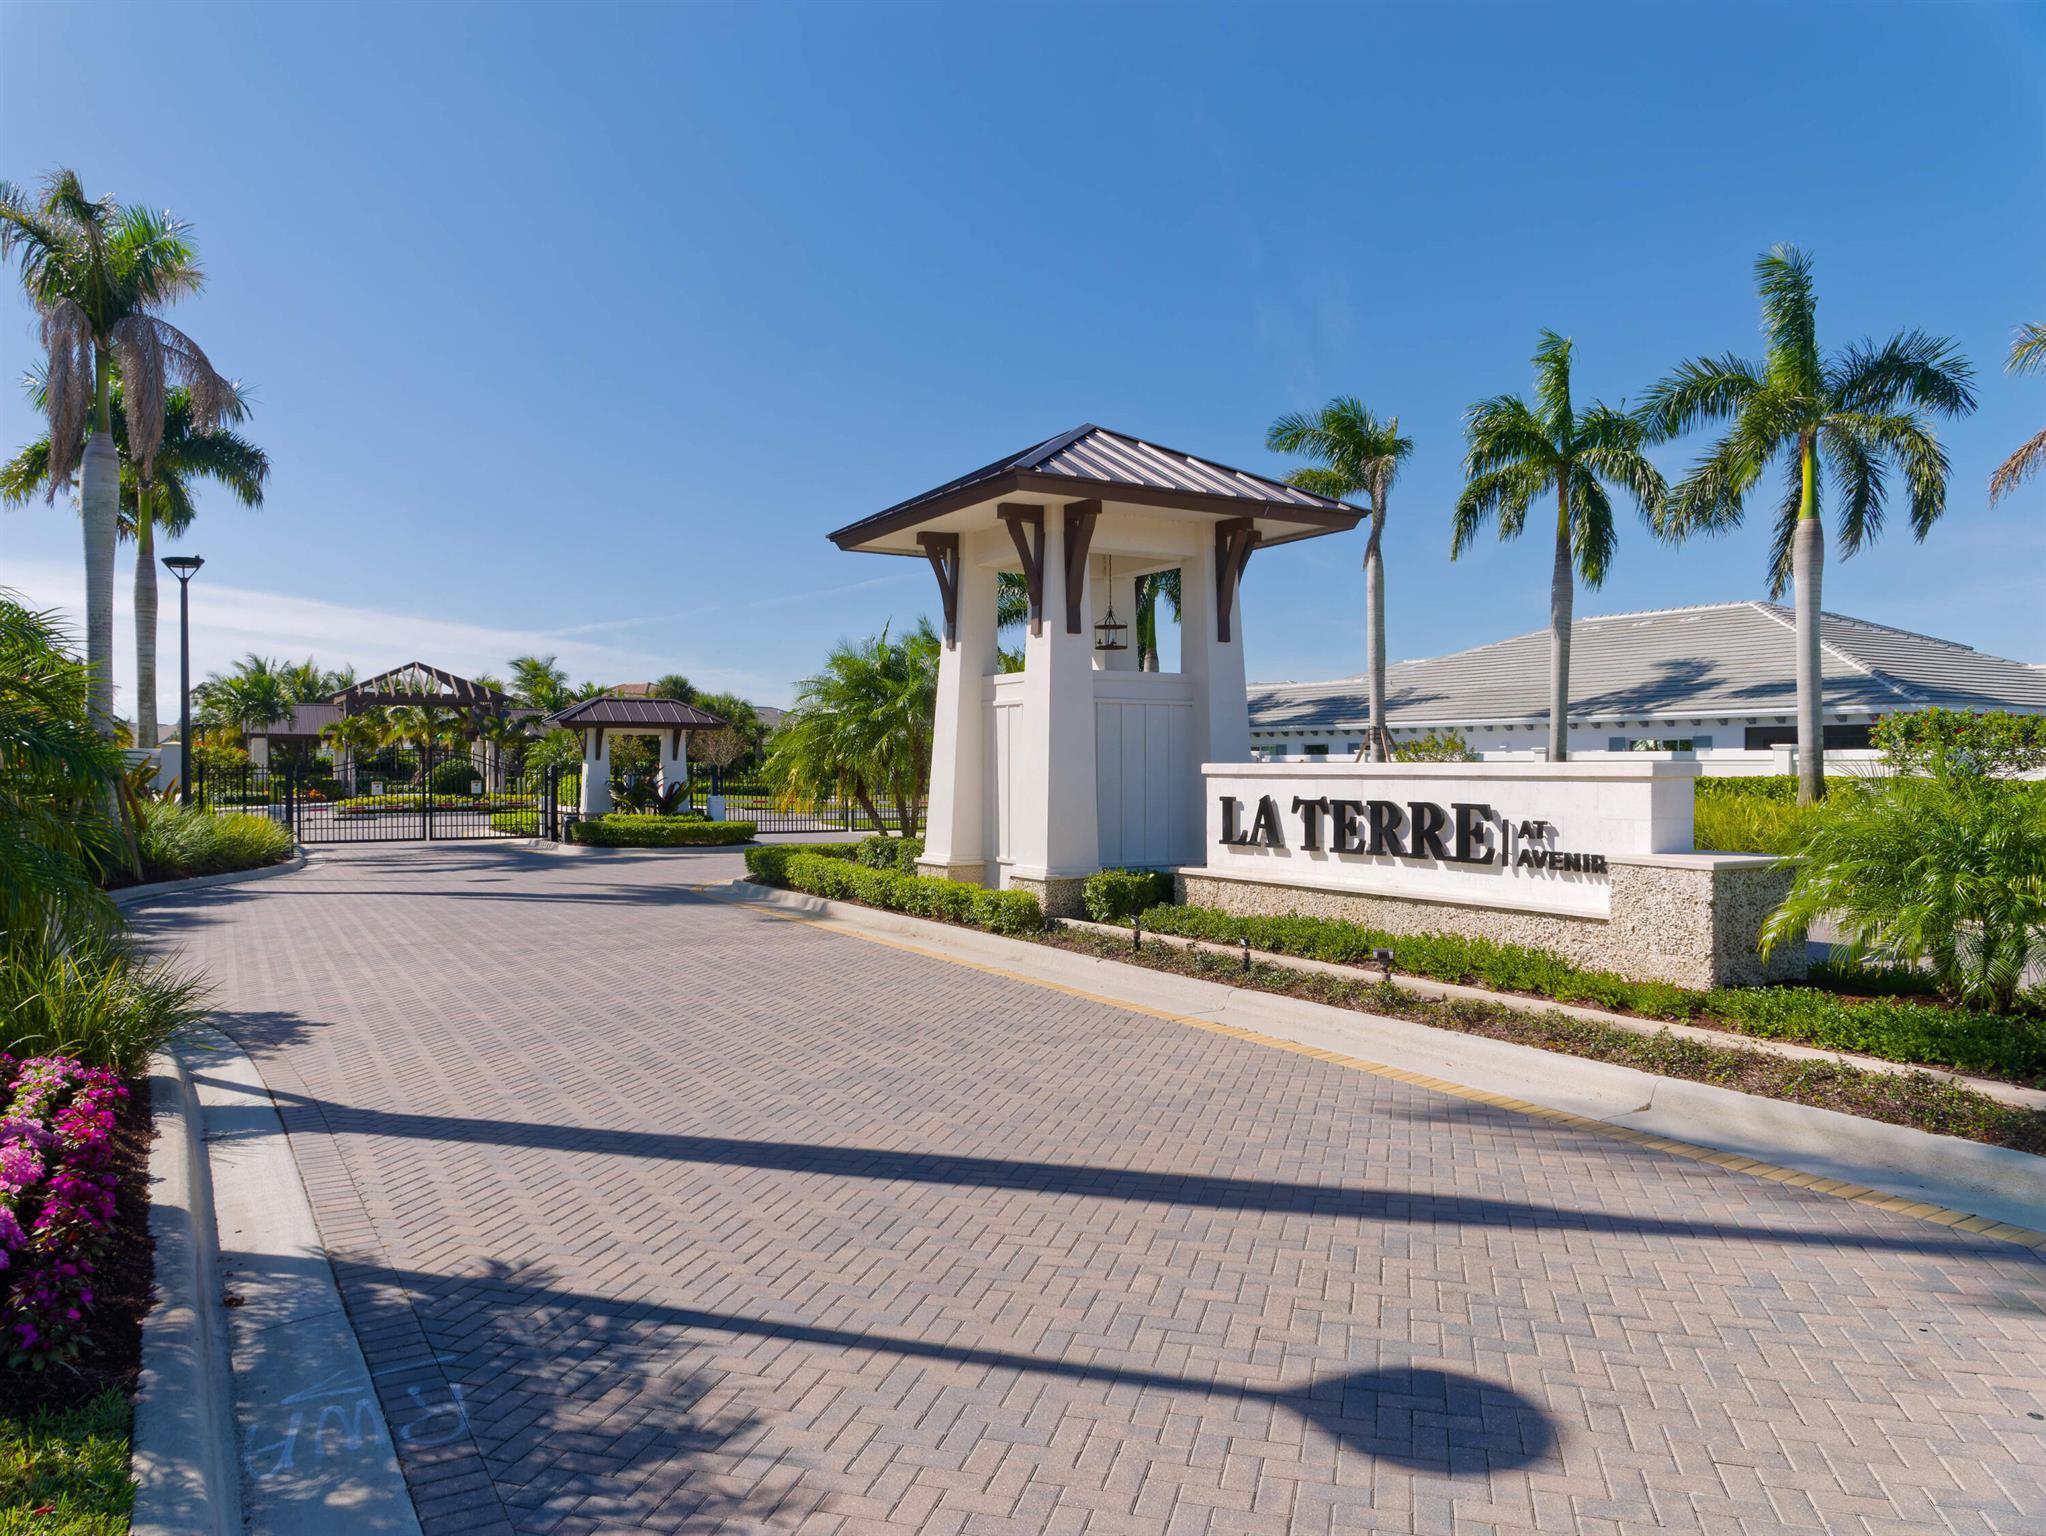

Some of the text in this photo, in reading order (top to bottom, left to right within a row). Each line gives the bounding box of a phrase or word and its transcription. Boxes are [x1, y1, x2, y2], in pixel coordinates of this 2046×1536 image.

[1219, 795, 1496, 865] LA TERRE
[1517, 820, 1548, 839] AT
[1516, 848, 1609, 874] AVENIR
